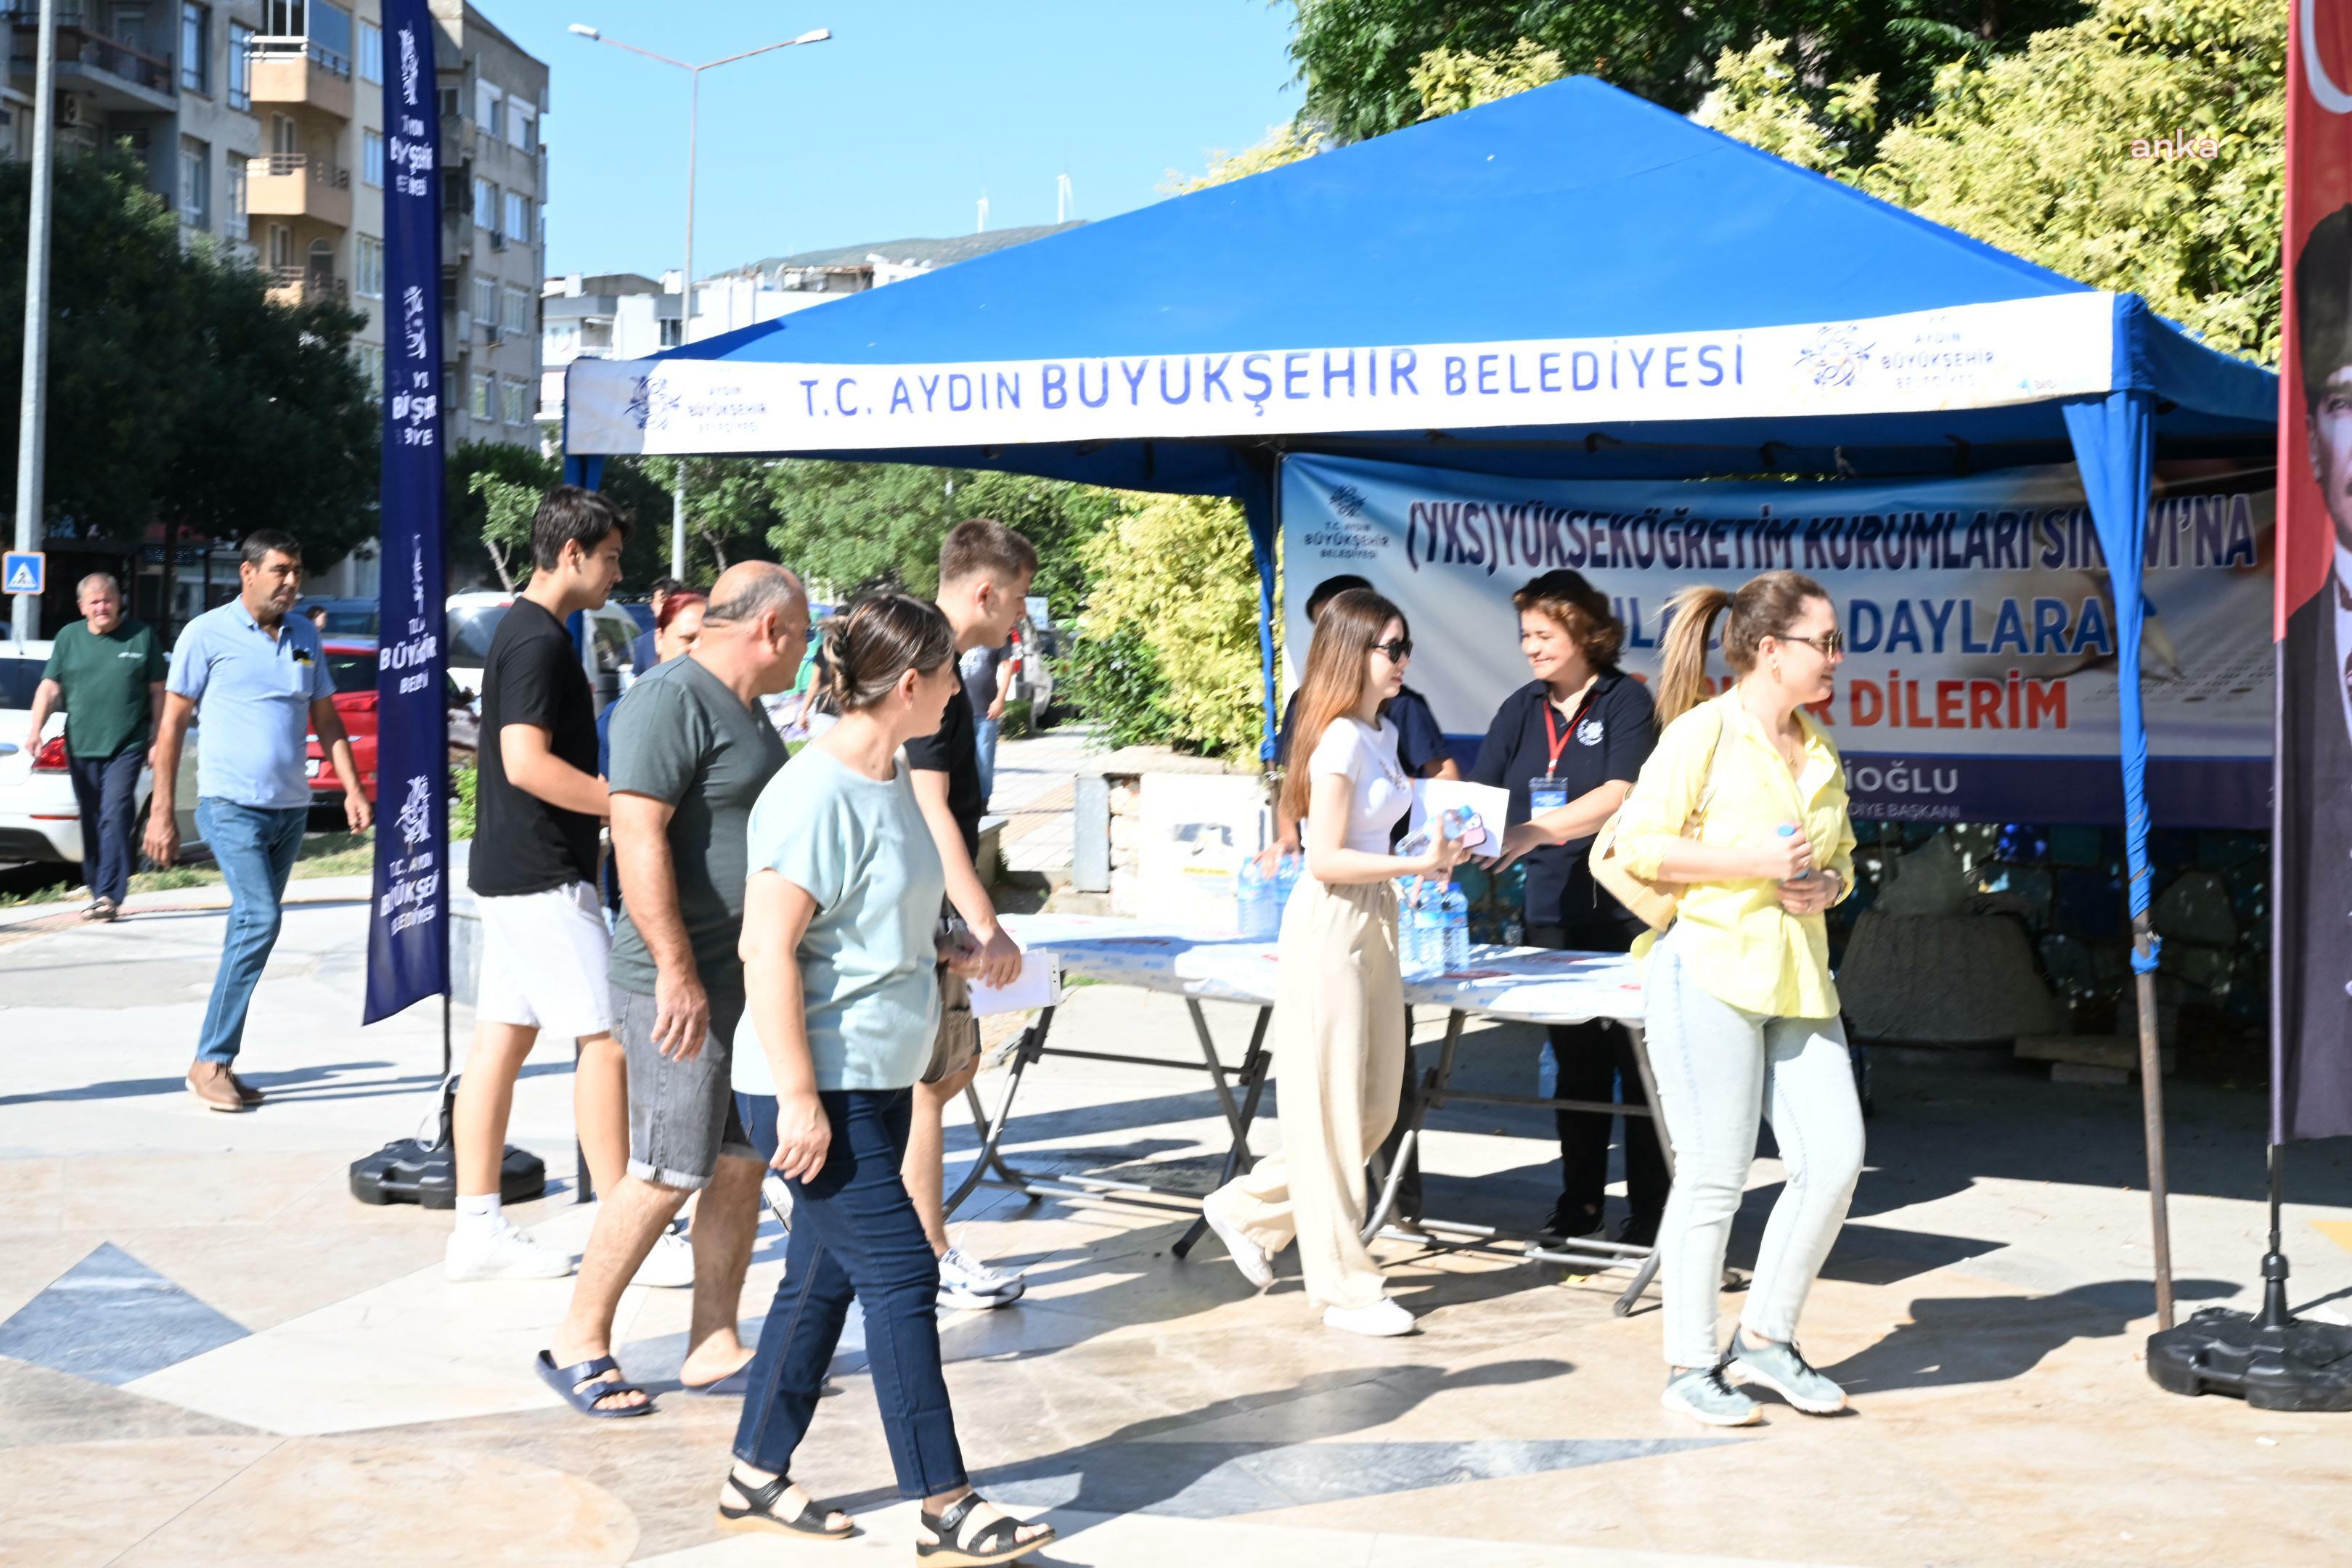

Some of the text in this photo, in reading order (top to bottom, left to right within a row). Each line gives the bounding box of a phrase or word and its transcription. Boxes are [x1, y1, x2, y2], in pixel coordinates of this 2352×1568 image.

[799, 377, 872, 416] T.C.
[889, 372, 1021, 415] AYDIN
[1445, 334, 1743, 396] BELEDİYESİ
[1805, 510, 2032, 571] KURUMLARI
[2039, 494, 2257, 571] SINVI'NA
[1839, 597, 2115, 655] DAYLARA
[1848, 668, 2069, 730] DİLERİM
[1845, 759, 1959, 794] İOĞLU
[1848, 801, 1885, 817] DİYE
